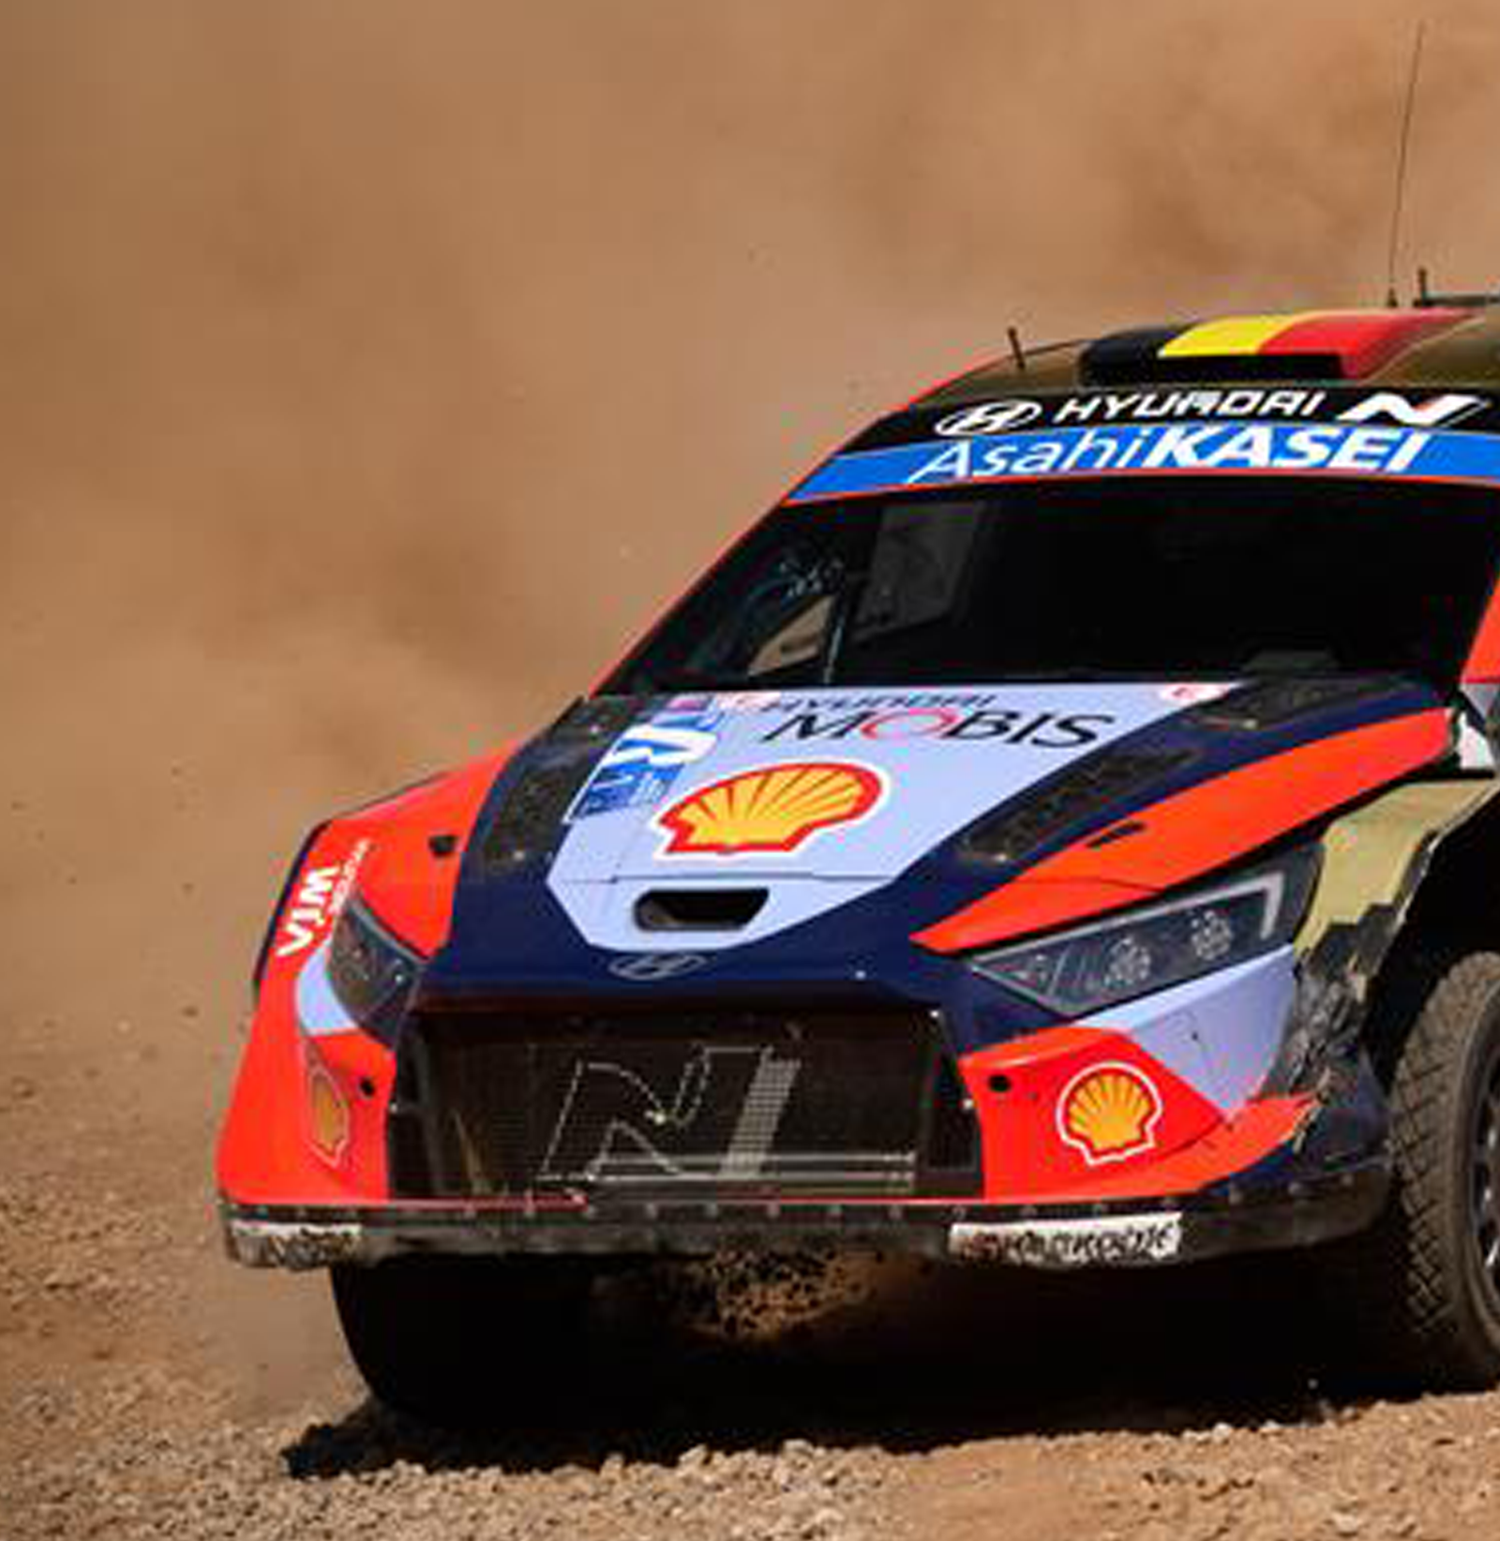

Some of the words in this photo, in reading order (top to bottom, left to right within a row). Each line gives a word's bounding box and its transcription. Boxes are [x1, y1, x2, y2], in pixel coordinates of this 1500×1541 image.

[1052, 388, 1328, 424] HYUNDAI
[1335, 392, 1492, 428] N
[760, 706, 1117, 749] MOBIS
